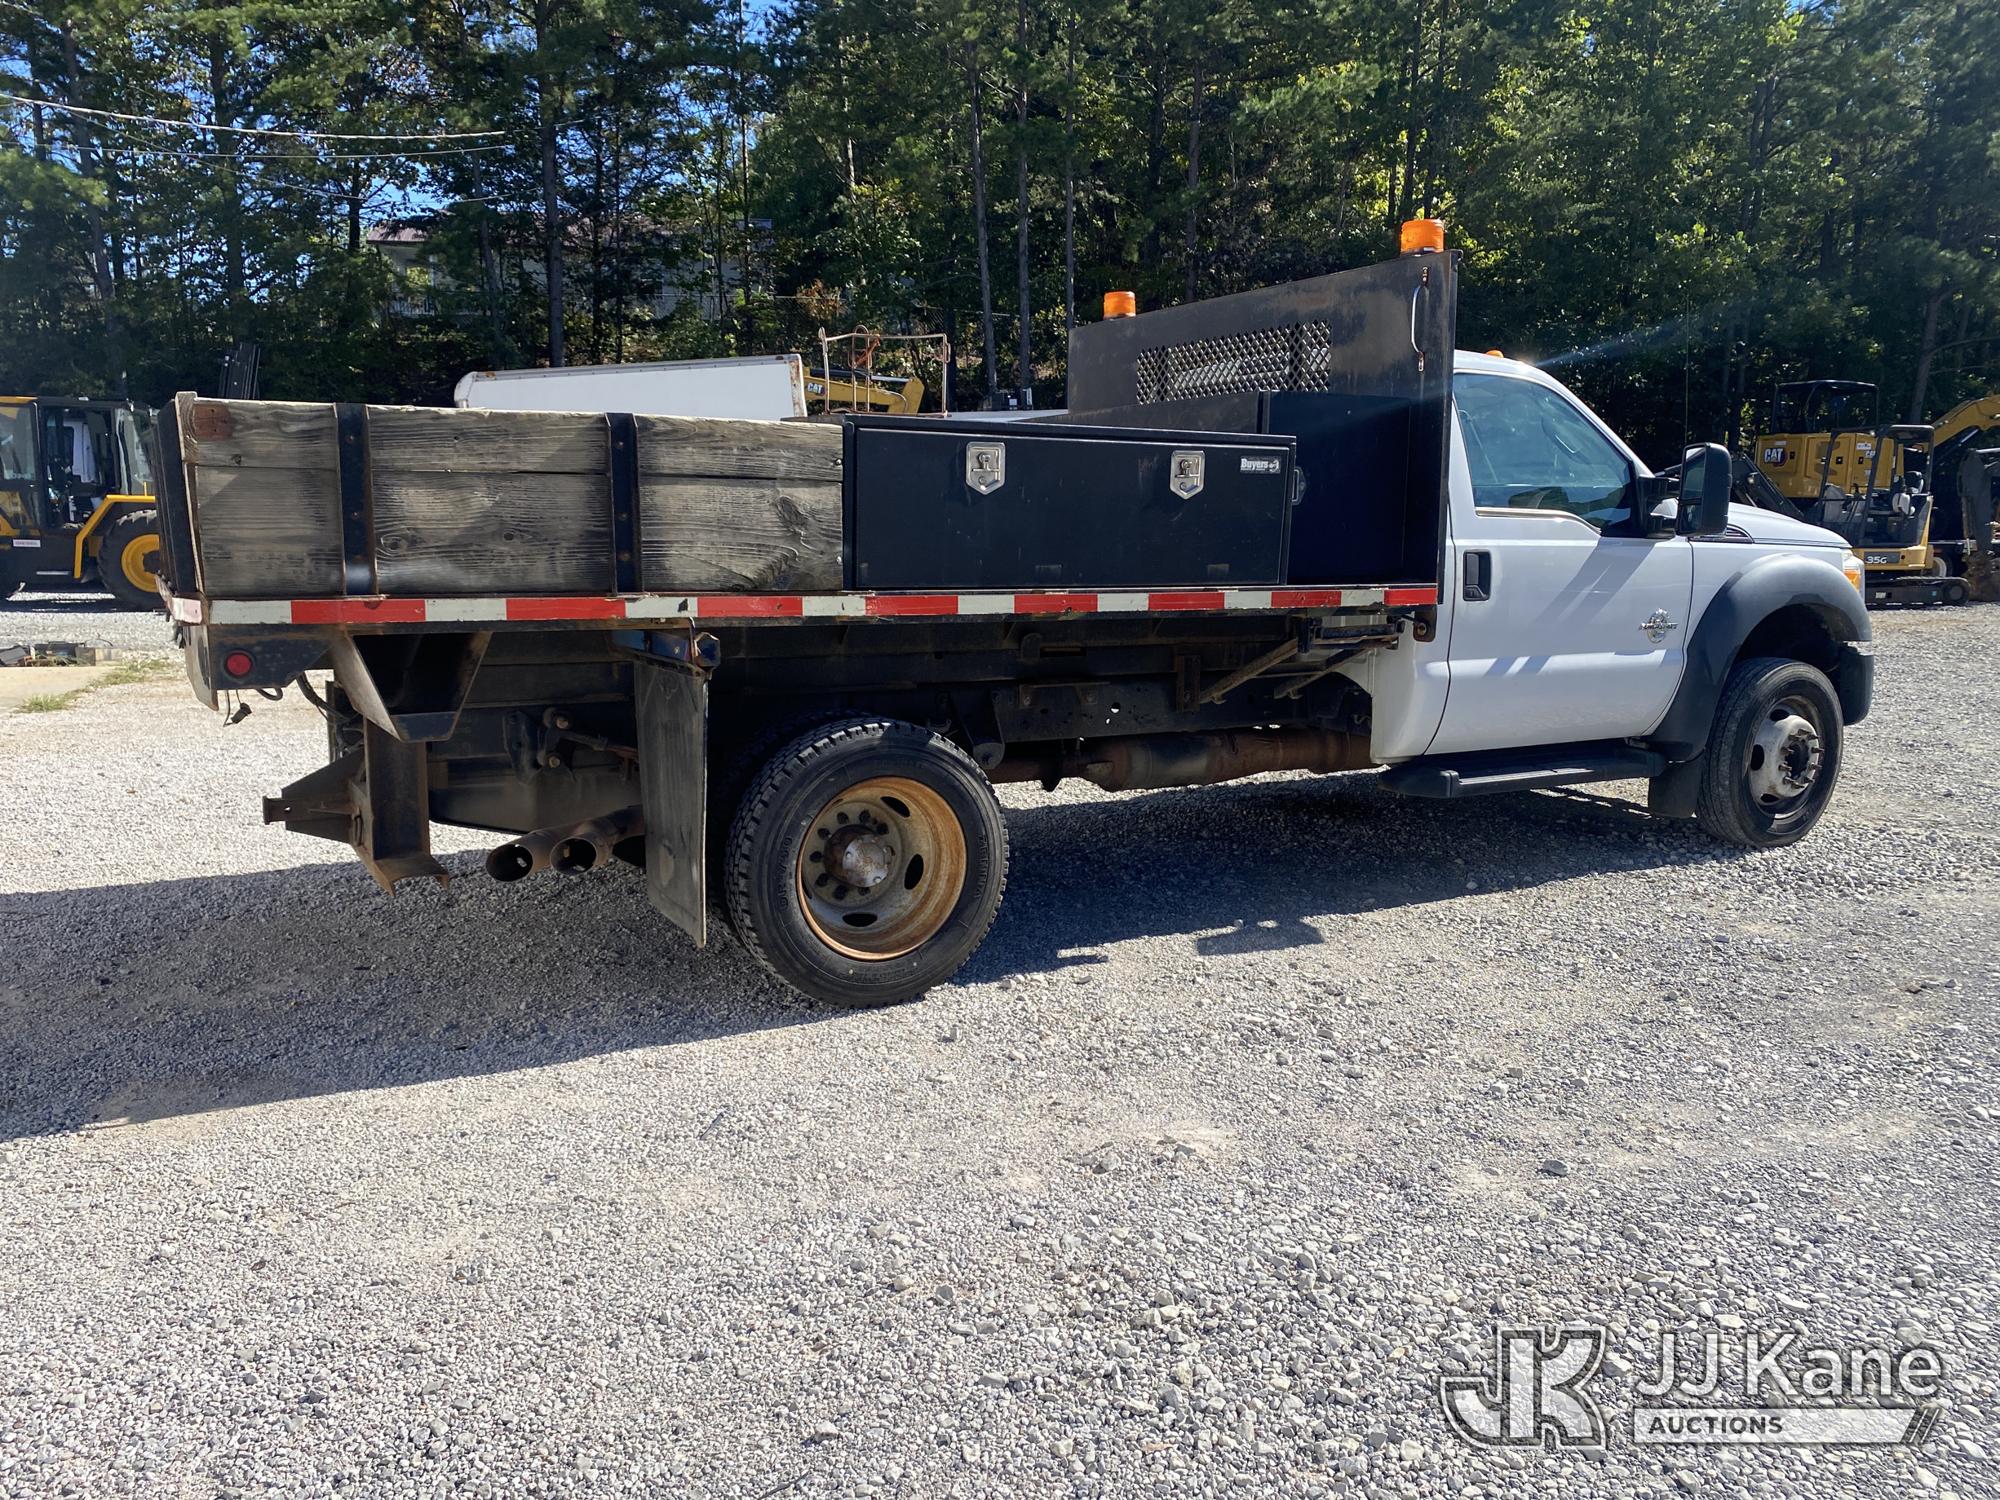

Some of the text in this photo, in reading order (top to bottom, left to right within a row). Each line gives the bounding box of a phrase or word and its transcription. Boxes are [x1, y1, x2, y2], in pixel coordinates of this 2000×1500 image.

[807, 382, 823, 394] CAT
[1764, 448, 1784, 463] CAT
[1241, 458, 1269, 471] Buyers
[1866, 556, 1888, 564] 35G
